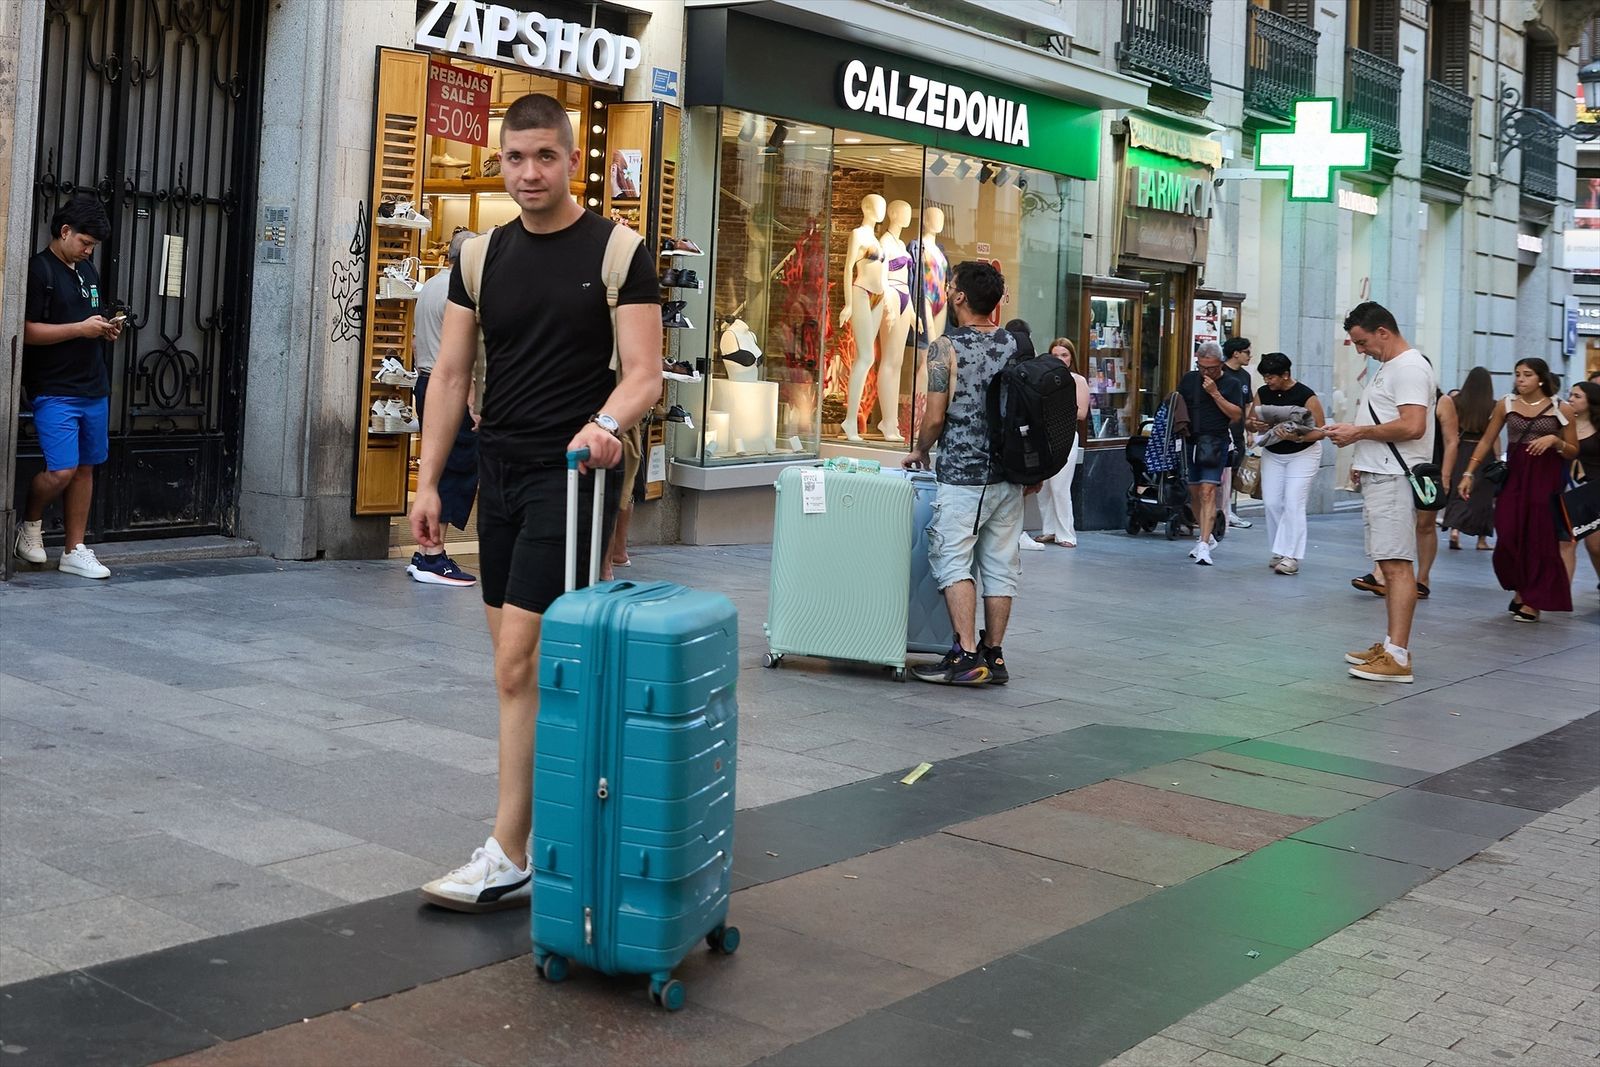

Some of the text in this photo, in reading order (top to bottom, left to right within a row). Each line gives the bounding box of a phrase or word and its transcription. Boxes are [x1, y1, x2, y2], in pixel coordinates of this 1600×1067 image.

[416, 0, 641, 86] ZAPSHOP
[430, 66, 489, 93] REBAJAS
[441, 85, 475, 106] SALE
[430, 105, 482, 141] -50%
[844, 60, 1029, 147] CALZEDONIA
[1136, 166, 1216, 218] FARMACIA
